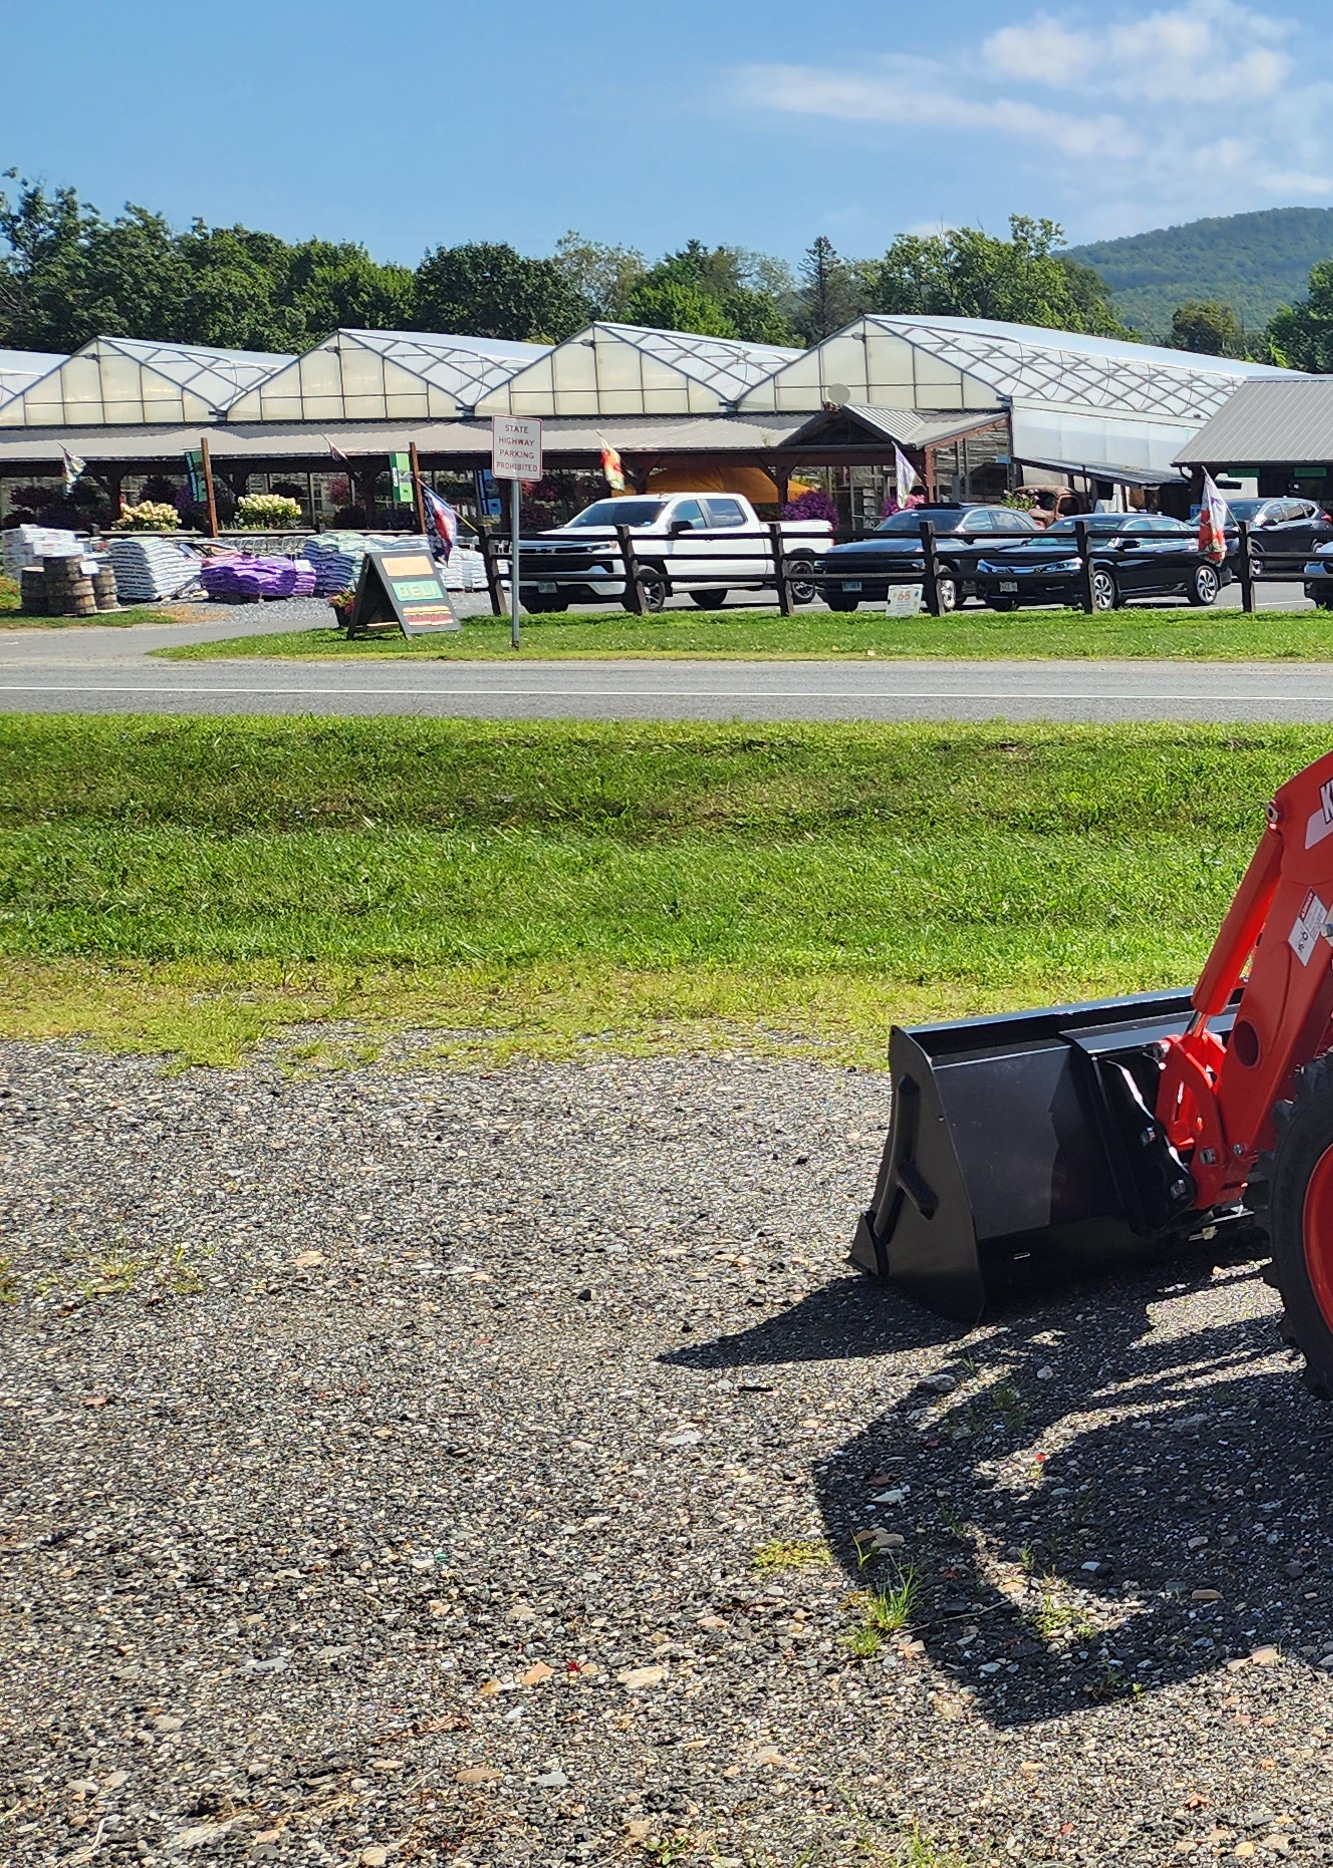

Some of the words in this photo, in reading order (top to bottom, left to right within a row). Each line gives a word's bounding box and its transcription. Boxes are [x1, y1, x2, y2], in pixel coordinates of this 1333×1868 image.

[505, 424, 529, 434] STATE
[498, 436, 534, 446] HIGHWAY
[499, 449, 534, 459] PARKING
[496, 461, 538, 472] PROHIBITED
[400, 584, 438, 598] DELI
